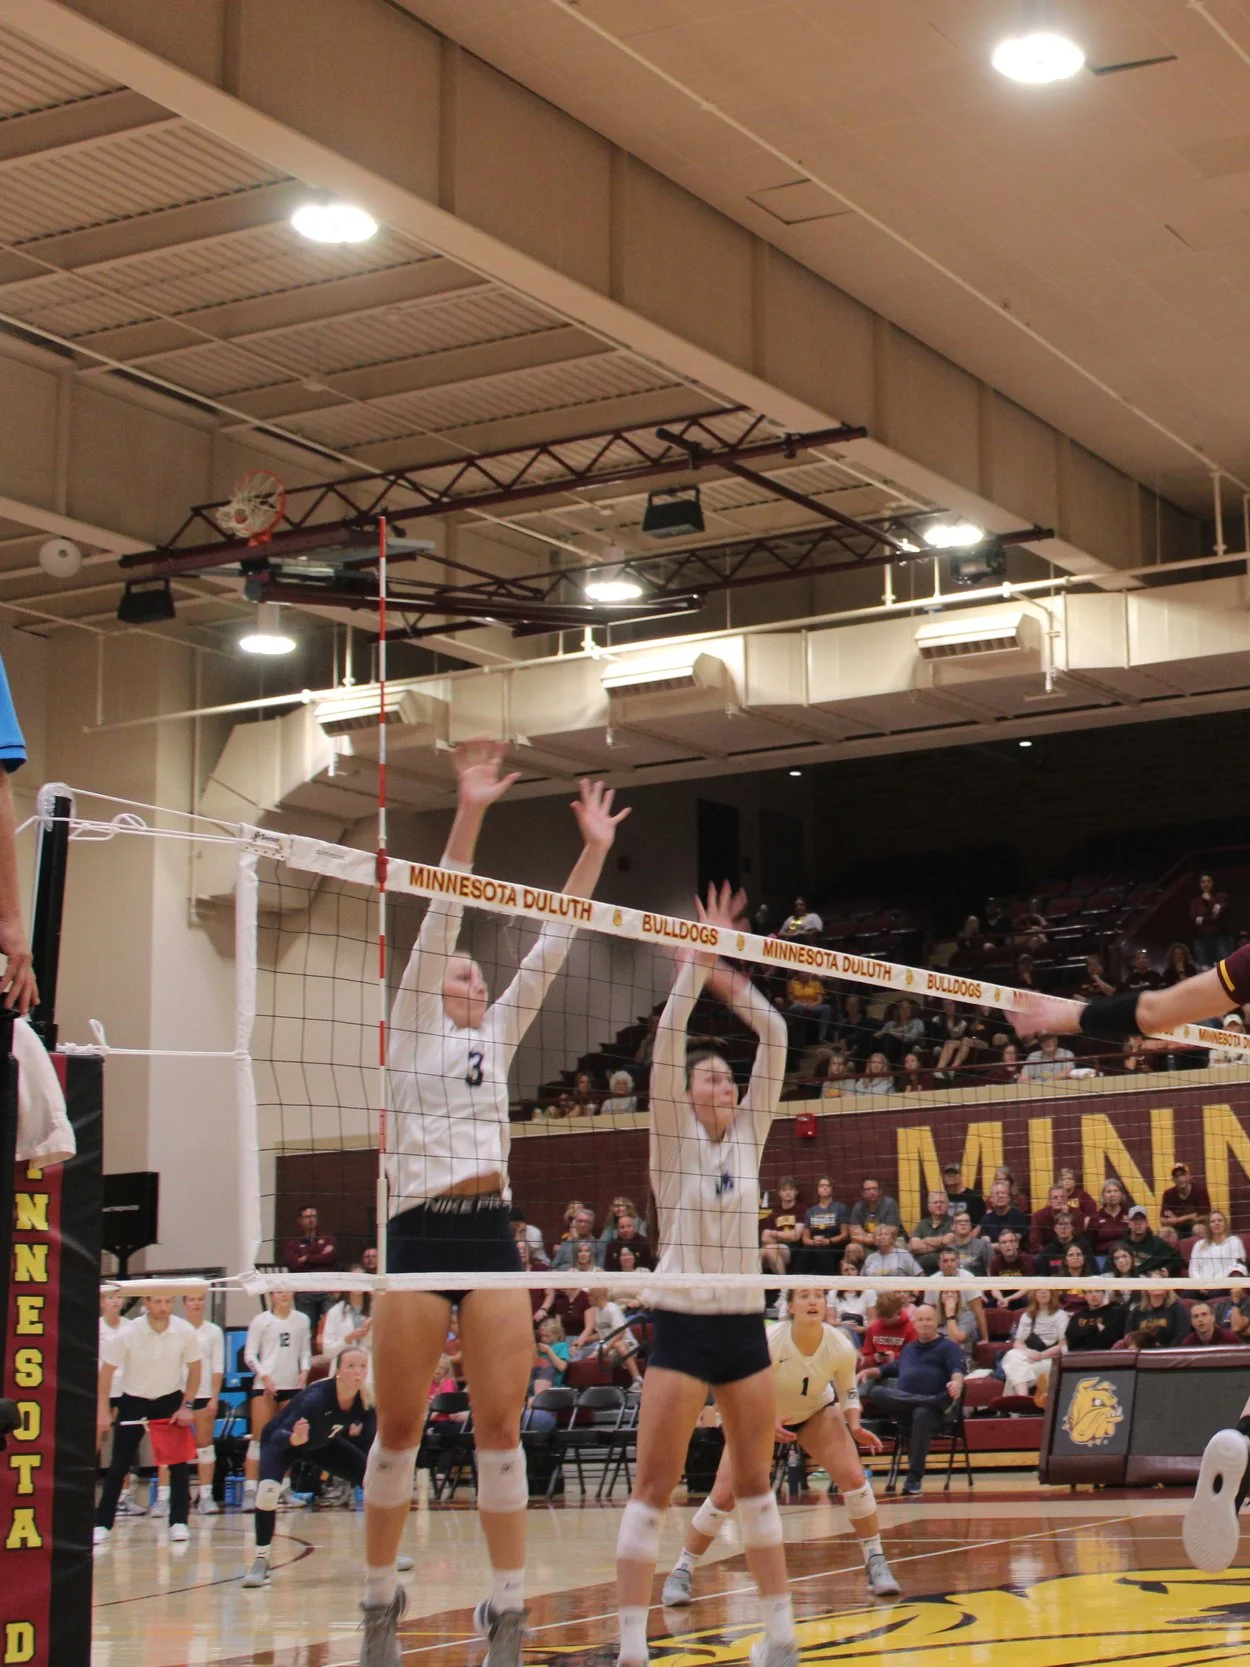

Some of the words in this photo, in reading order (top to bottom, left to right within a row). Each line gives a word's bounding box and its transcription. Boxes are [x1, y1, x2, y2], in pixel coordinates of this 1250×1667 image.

[410, 865, 517, 907] MINNESOTA
[523, 889, 593, 922] DULUTH
[642, 914, 719, 946] BULLDOGS
[762, 939, 838, 971] MINNESOTA
[842, 956, 892, 981] DULUTH
[927, 973, 982, 999] BULLDOGS
[1199, 1028, 1241, 1047] MINNESOTA
[466, 1051, 484, 1087] 3
[279, 1332, 291, 1347] 12
[801, 1377, 809, 1396] 1
[328, 1424, 344, 1439] 7
